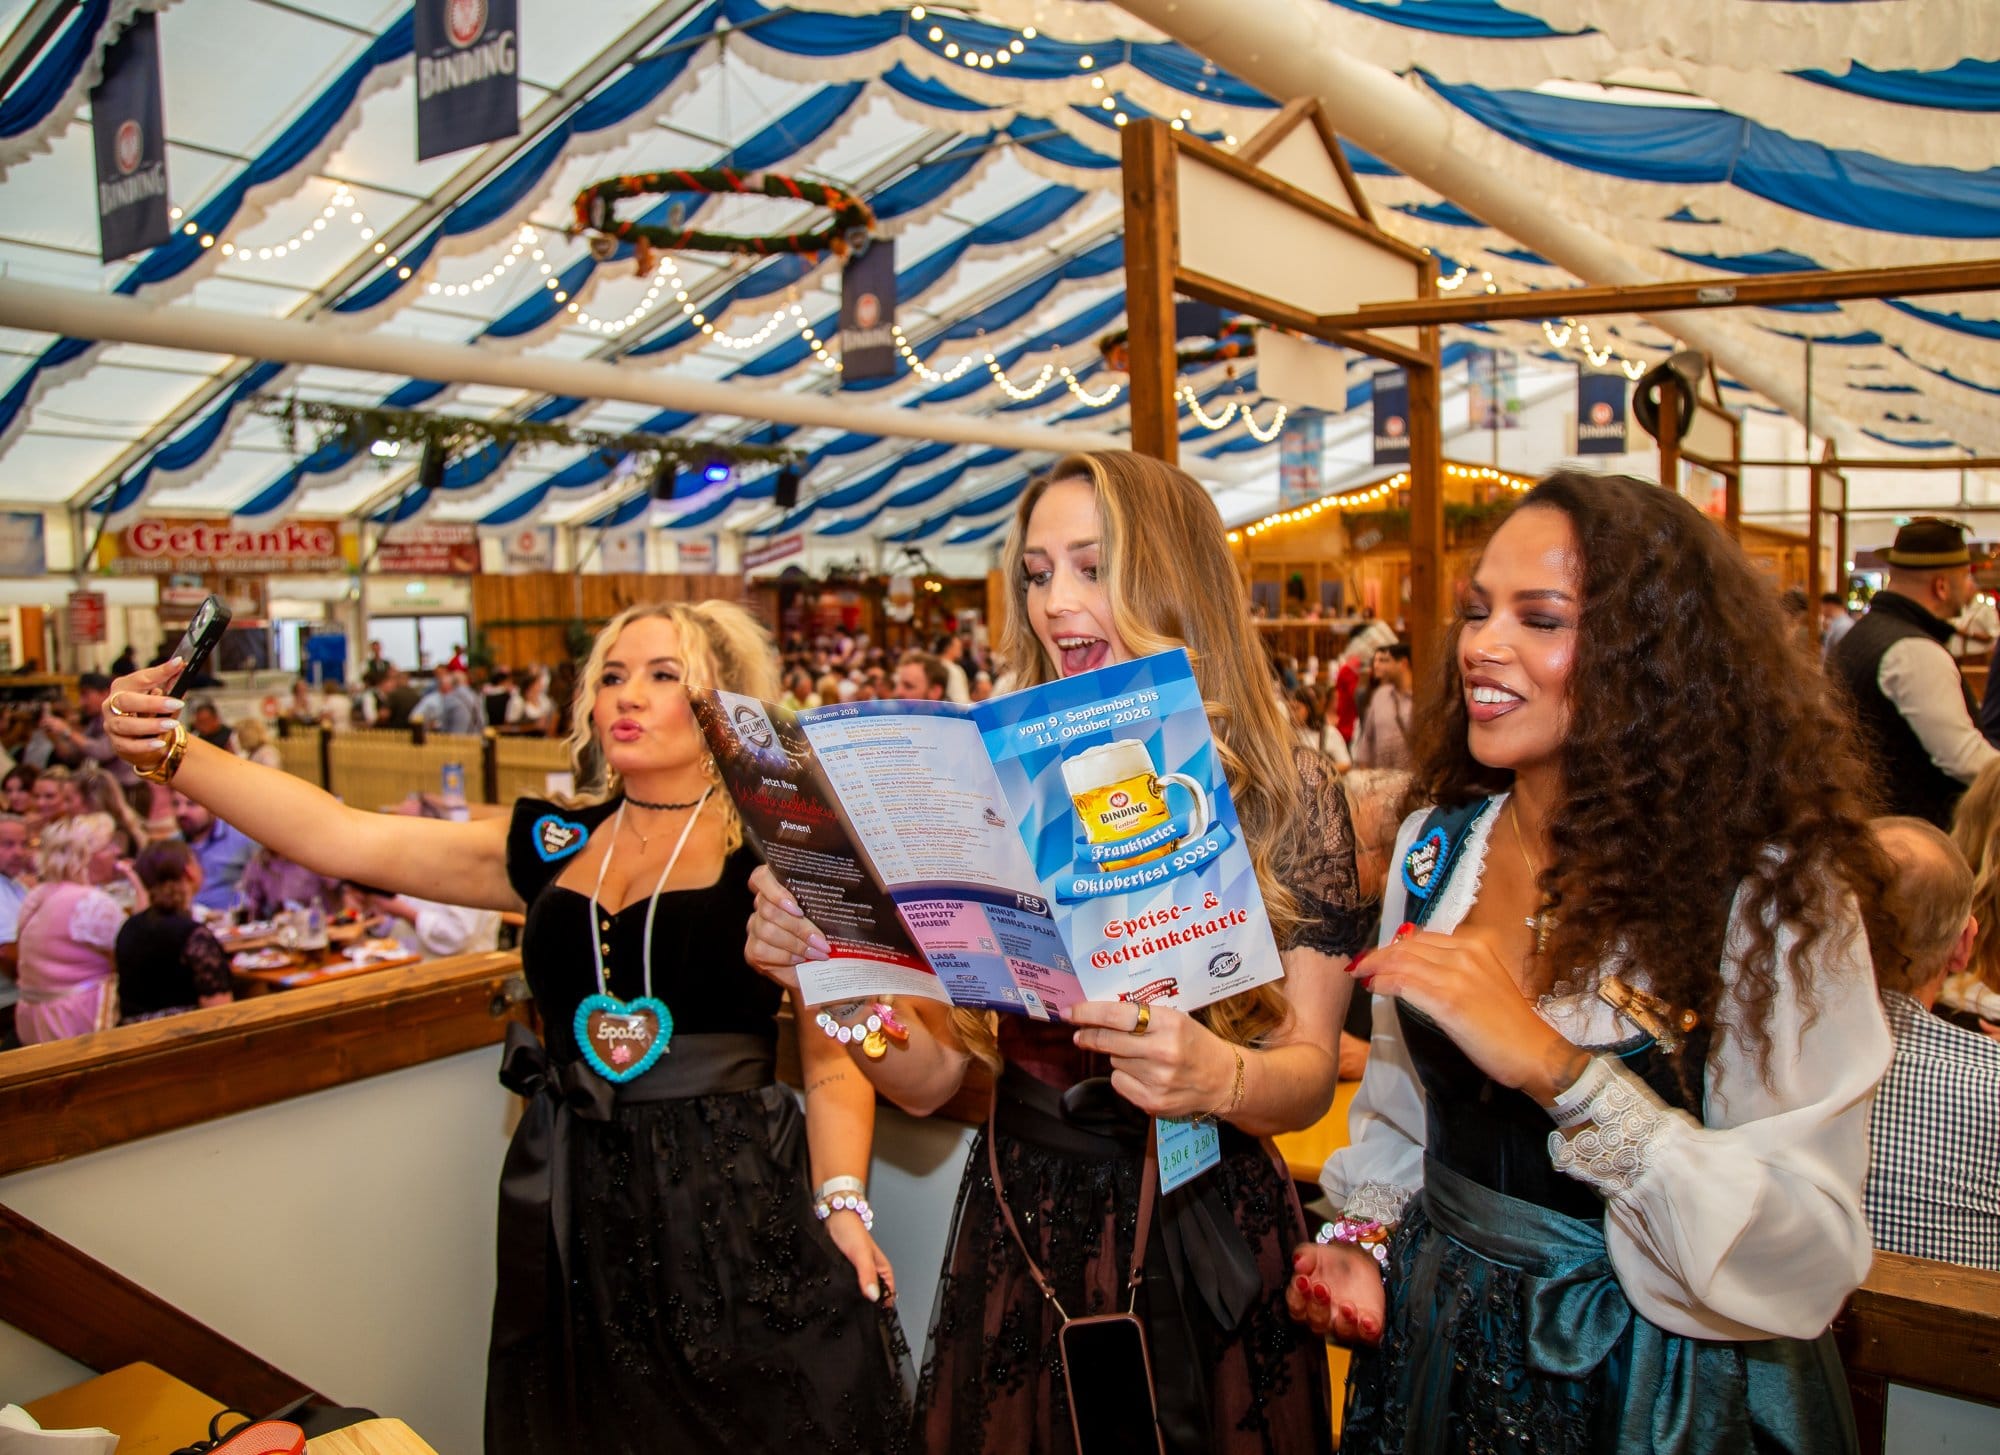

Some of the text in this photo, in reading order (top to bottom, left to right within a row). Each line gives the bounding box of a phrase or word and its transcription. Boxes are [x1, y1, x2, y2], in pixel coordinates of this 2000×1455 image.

[418, 29, 515, 101] BINDING
[804, 707, 859, 723] Programm 2026
[1018, 690, 1160, 737] vom 9. September bis
[738, 718, 769, 738] NO LIMIT
[1036, 705, 1152, 746] 11. Oktober 2026
[1100, 801, 1148, 825] BINDING
[1091, 822, 1178, 861] Frankfurter
[1072, 837, 1220, 895] Oktoberfest 2026
[902, 902, 965, 912] RICHTIG AUF
[1016, 893, 1040, 908] FES
[907, 910, 957, 921] DEN PUTZ
[985, 905, 1017, 918] MINUS
[1103, 889, 1221, 939] Speise- &
[911, 919, 951, 929] HAUEN!
[997, 916, 1027, 929] MINUS
[1033, 924, 1057, 938] PLUS
[1090, 908, 1249, 970] Getränkekarte
[930, 953, 957, 961] LASS
[934, 961, 971, 969] HOLEN!
[1010, 958, 1051, 976] FLASCHE
[1209, 952, 1240, 978] NO LIMIT
[1184, 1144, 1189, 1160] €
